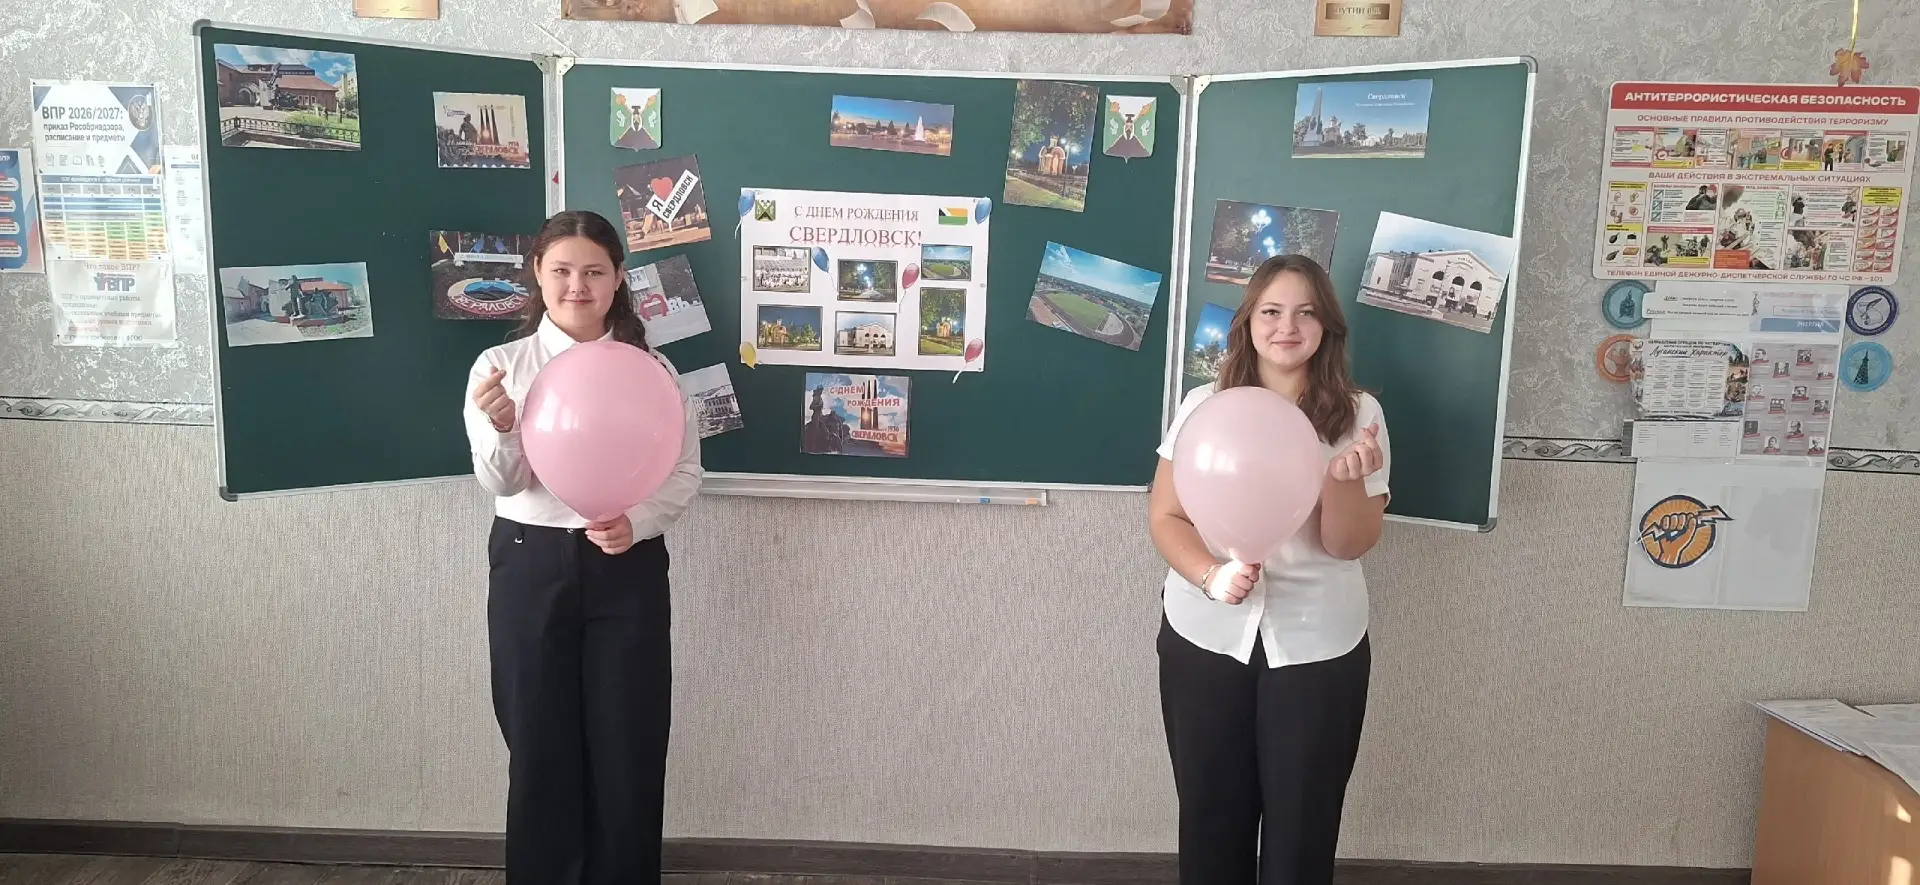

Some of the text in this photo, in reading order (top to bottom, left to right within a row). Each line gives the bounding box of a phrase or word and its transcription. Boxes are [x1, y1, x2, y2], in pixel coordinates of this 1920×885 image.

[1625, 92, 1906, 106] АНТИТЕРРОРИСТИЧЕСКАЯ БЕЗОПАСНОСТЬ
[42, 106, 124, 120] ВПР 2026/2027:
[1638, 114, 1688, 122] ОСНОВНЫЕ
[1691, 116, 1733, 124] ПРАВИЛА
[1736, 116, 1826, 124] ПРОТИВОДЕЙСТВИЯ
[44, 124, 68, 132] приказ
[45, 134, 84, 142] расписание
[92, 134, 126, 142] предметы
[1677, 172, 1725, 180] ДЕЙСТВИЯ
[1735, 173, 1816, 182] ЭКСТРЕМАЛЬНЫХ
[1818, 174, 1872, 182] СИТУАЦИЯХ
[662, 174, 694, 219] СВЕРДЛОВСК
[652, 199, 664, 212] Я
[794, 206, 919, 222] С ДНЕМ РОЖДЕНИЯ
[790, 226, 922, 246] СВЕРДЛОВСК!
[1678, 271, 1788, 280] ДЕЖУРНО-ДИСПЕТЧЕРСКОЙ
[106, 278, 136, 292] ВПР
[1650, 346, 1728, 358] Луганский Характер
[837, 385, 864, 394] ДНЕМ
[848, 398, 900, 408] РОЖДЕНИЯ
[852, 430, 898, 442] СВЕРДЛОВСК
